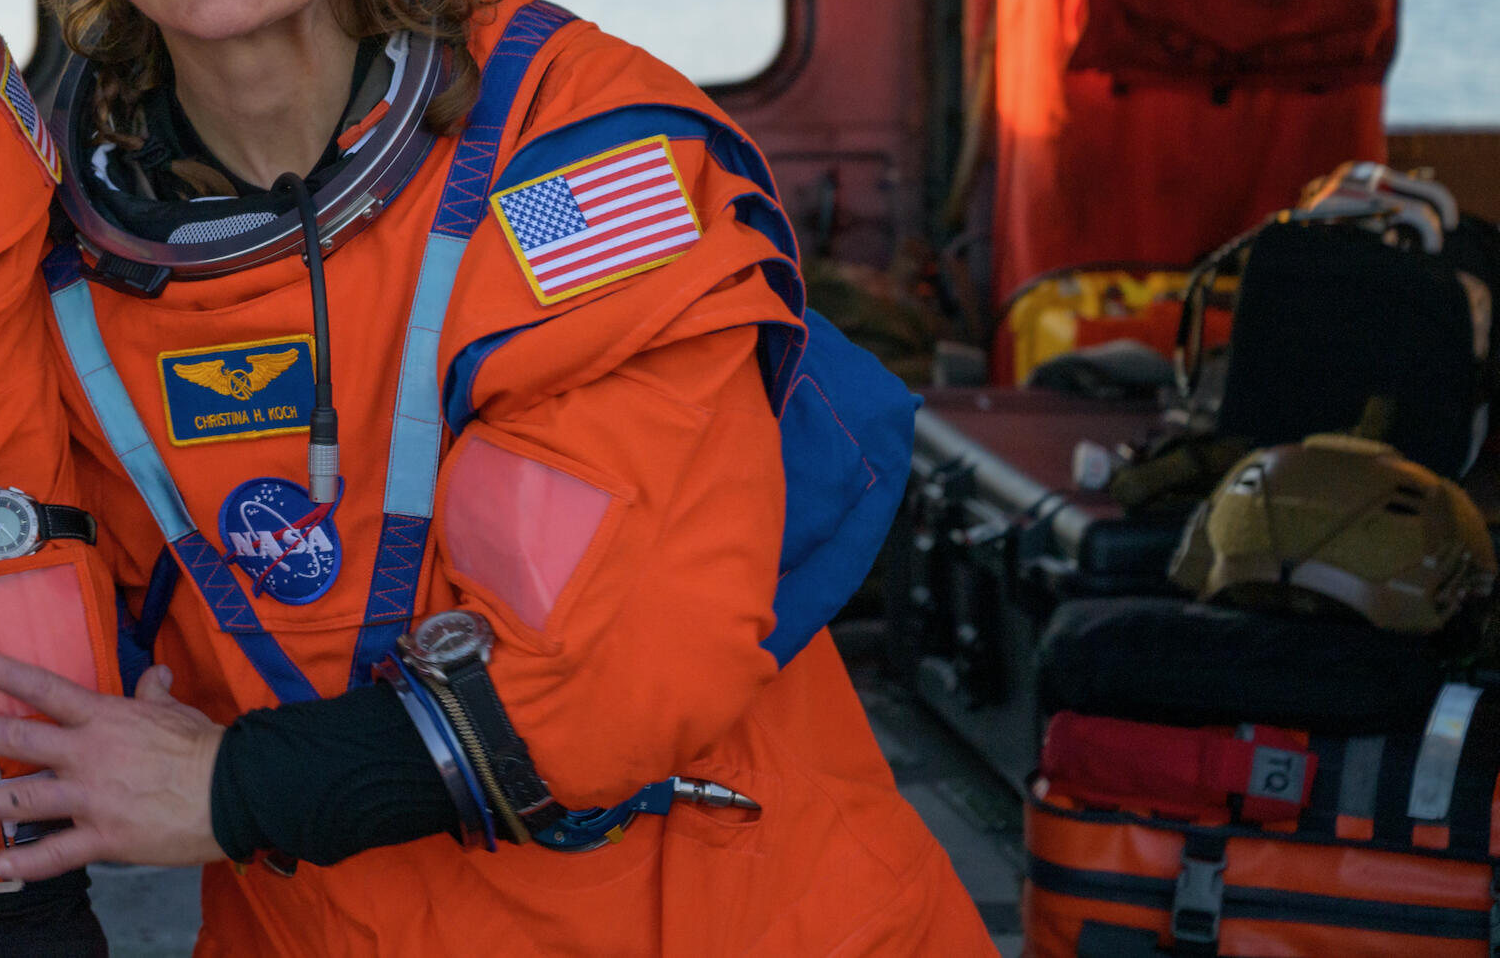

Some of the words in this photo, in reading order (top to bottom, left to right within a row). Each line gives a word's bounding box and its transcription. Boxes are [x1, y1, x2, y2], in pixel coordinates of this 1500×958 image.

[194, 409, 250, 431] CHRISTINA
[253, 407, 265, 422] H.
[267, 405, 298, 421] KOCH
[228, 525, 334, 557] NASA
[1262, 757, 1293, 795] TQ
